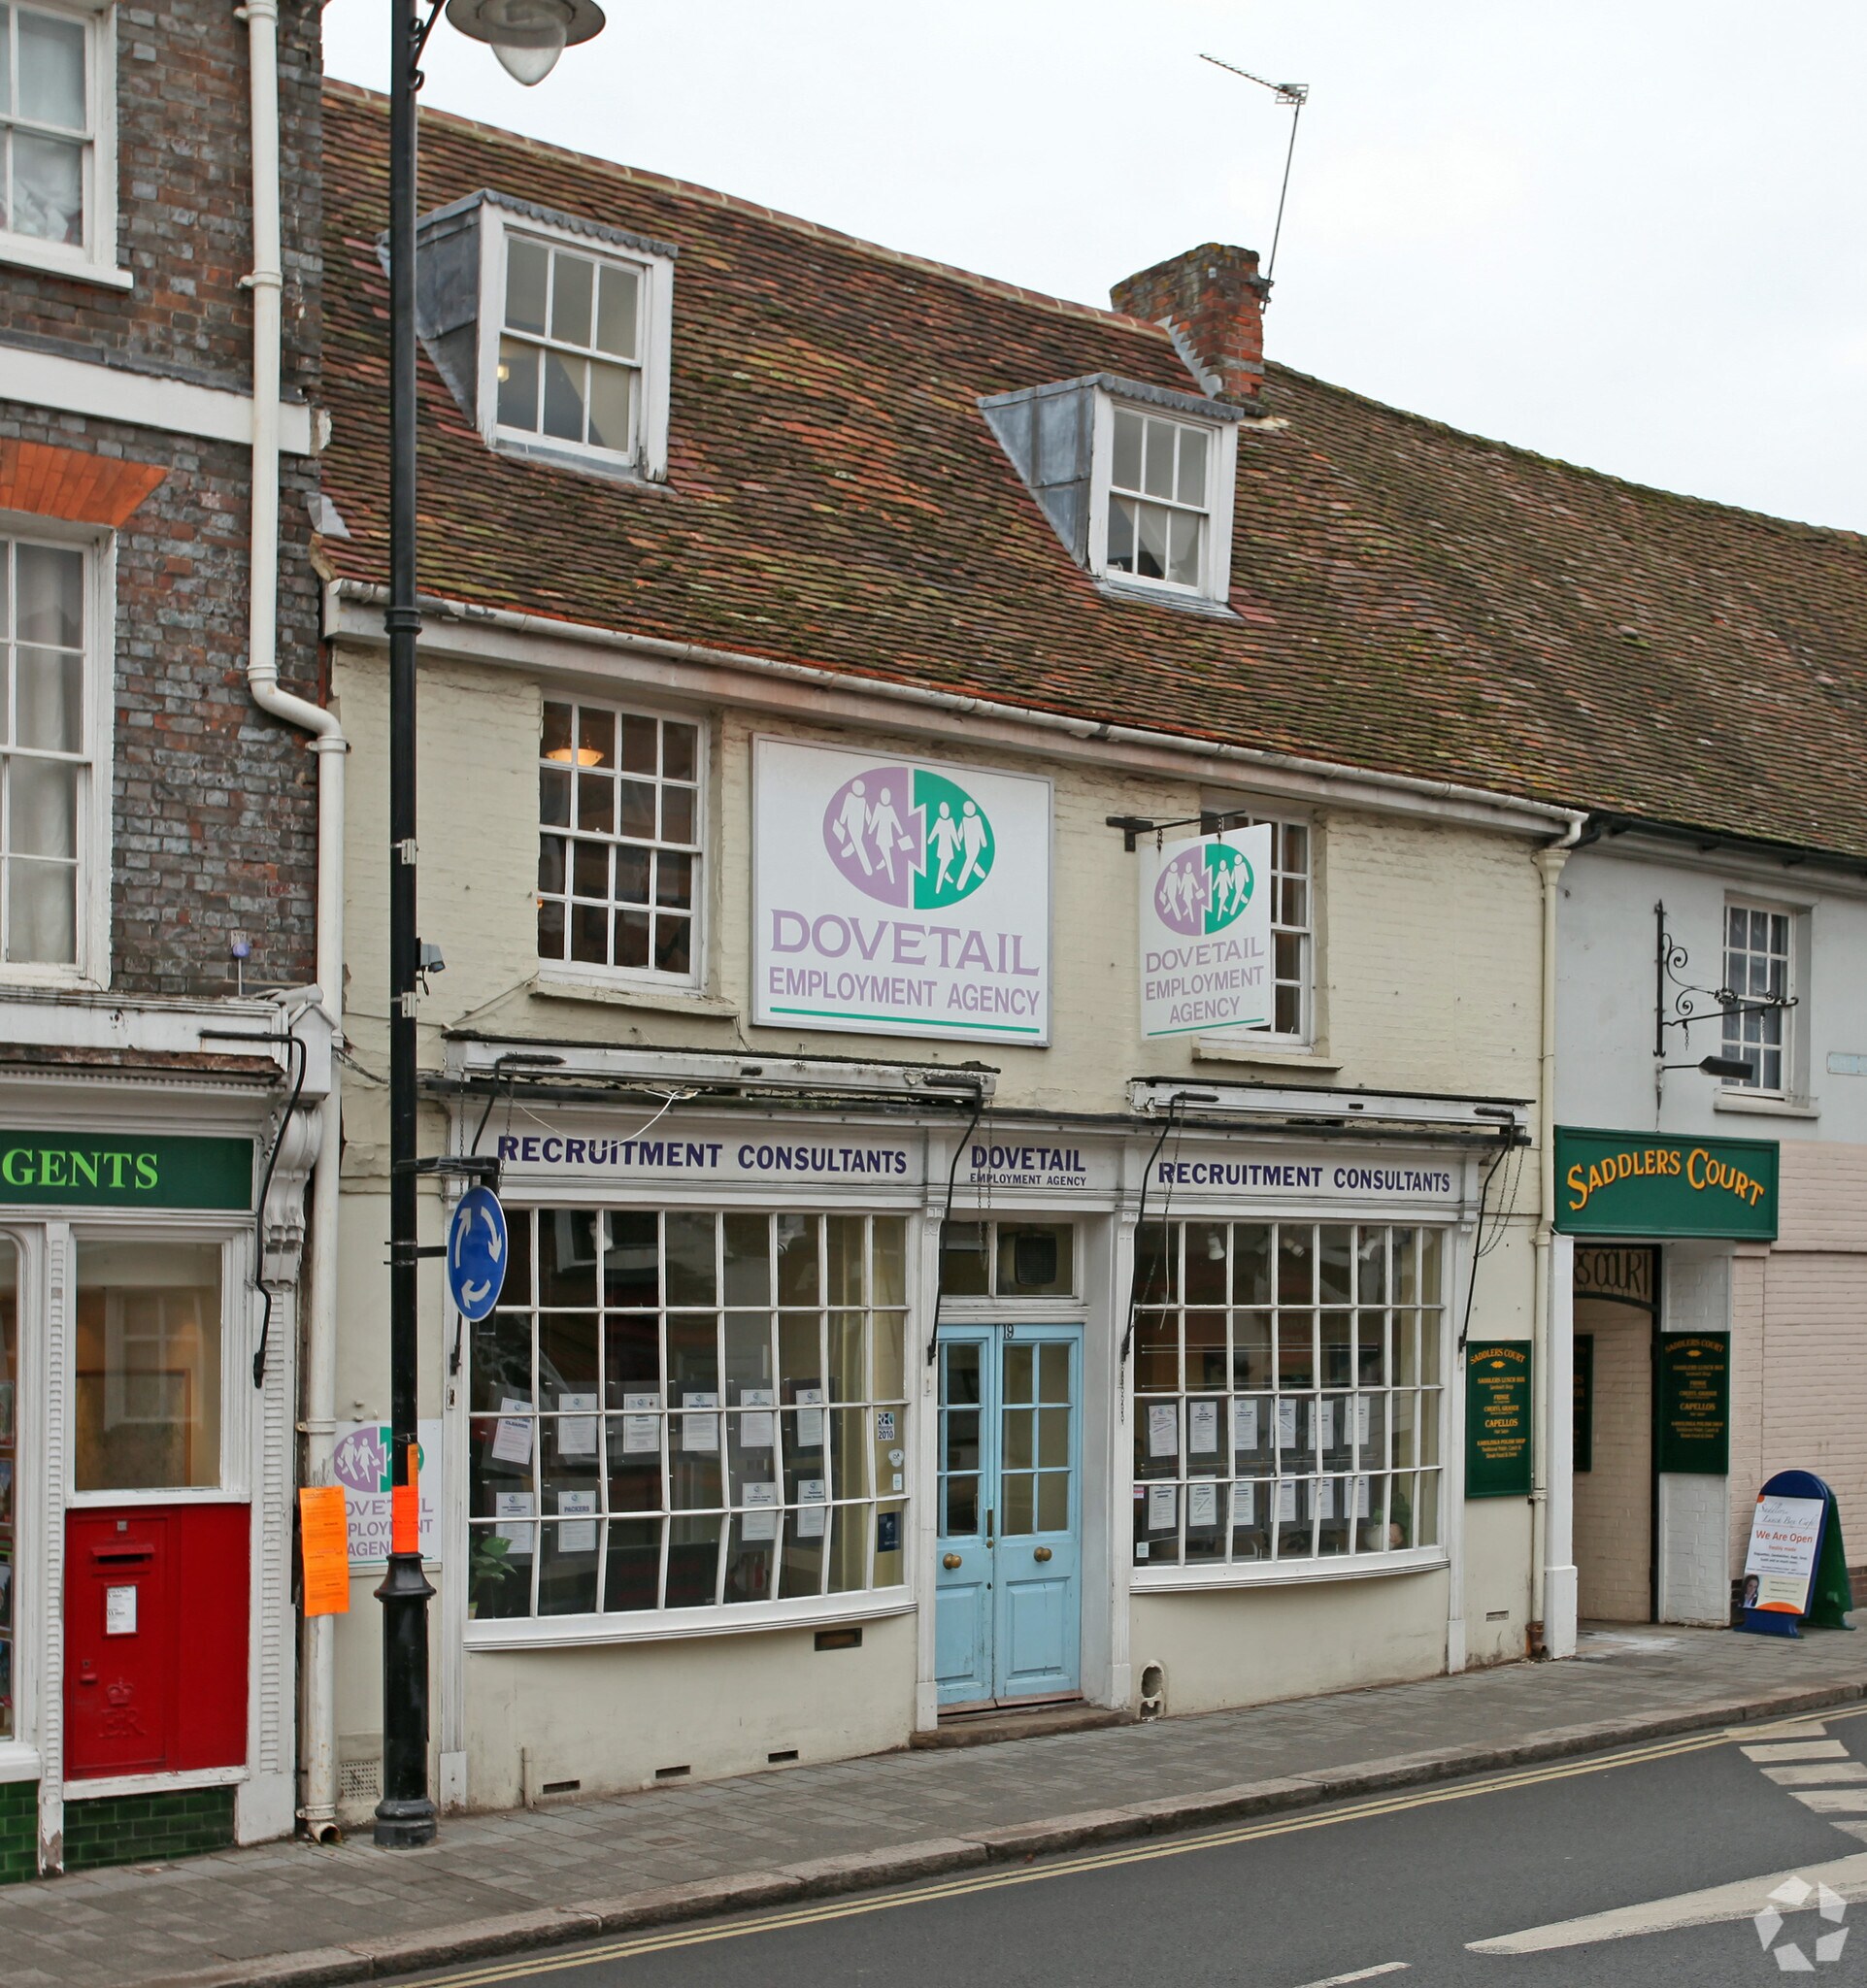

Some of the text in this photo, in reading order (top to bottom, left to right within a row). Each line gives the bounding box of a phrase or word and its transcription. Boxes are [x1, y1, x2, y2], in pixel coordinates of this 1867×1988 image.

[771, 909, 1040, 977] DOVETAIL
[1146, 936, 1264, 974] DOVETAIL
[769, 966, 1040, 1015] EMPLOYMENT AGENCY
[1146, 965, 1264, 1001] EMPLOYMENT
[1169, 995, 1241, 1024] AGENCY
[2, 1148, 159, 1189] GENTS
[498, 1135, 908, 1175] RECRUITMENT CONSULTANTS
[971, 1145, 1086, 1172] DOVETAIL
[971, 1173, 1086, 1186] EMPLOYMENT AGENCY
[1158, 1161, 1450, 1193] RECRUITMENT CONSULTANTS
[1567, 1147, 1765, 1210] SADDLERS COURT
[1003, 1324, 1015, 1340] 19
[1470, 1348, 1526, 1365] SADDLERS COURT
[878, 1431, 893, 1440] 2010
[1484, 1418, 1518, 1428] CAPELLOS
[348, 1541, 392, 1557] AGEN
[1755, 1530, 1813, 1543] We Are Open
